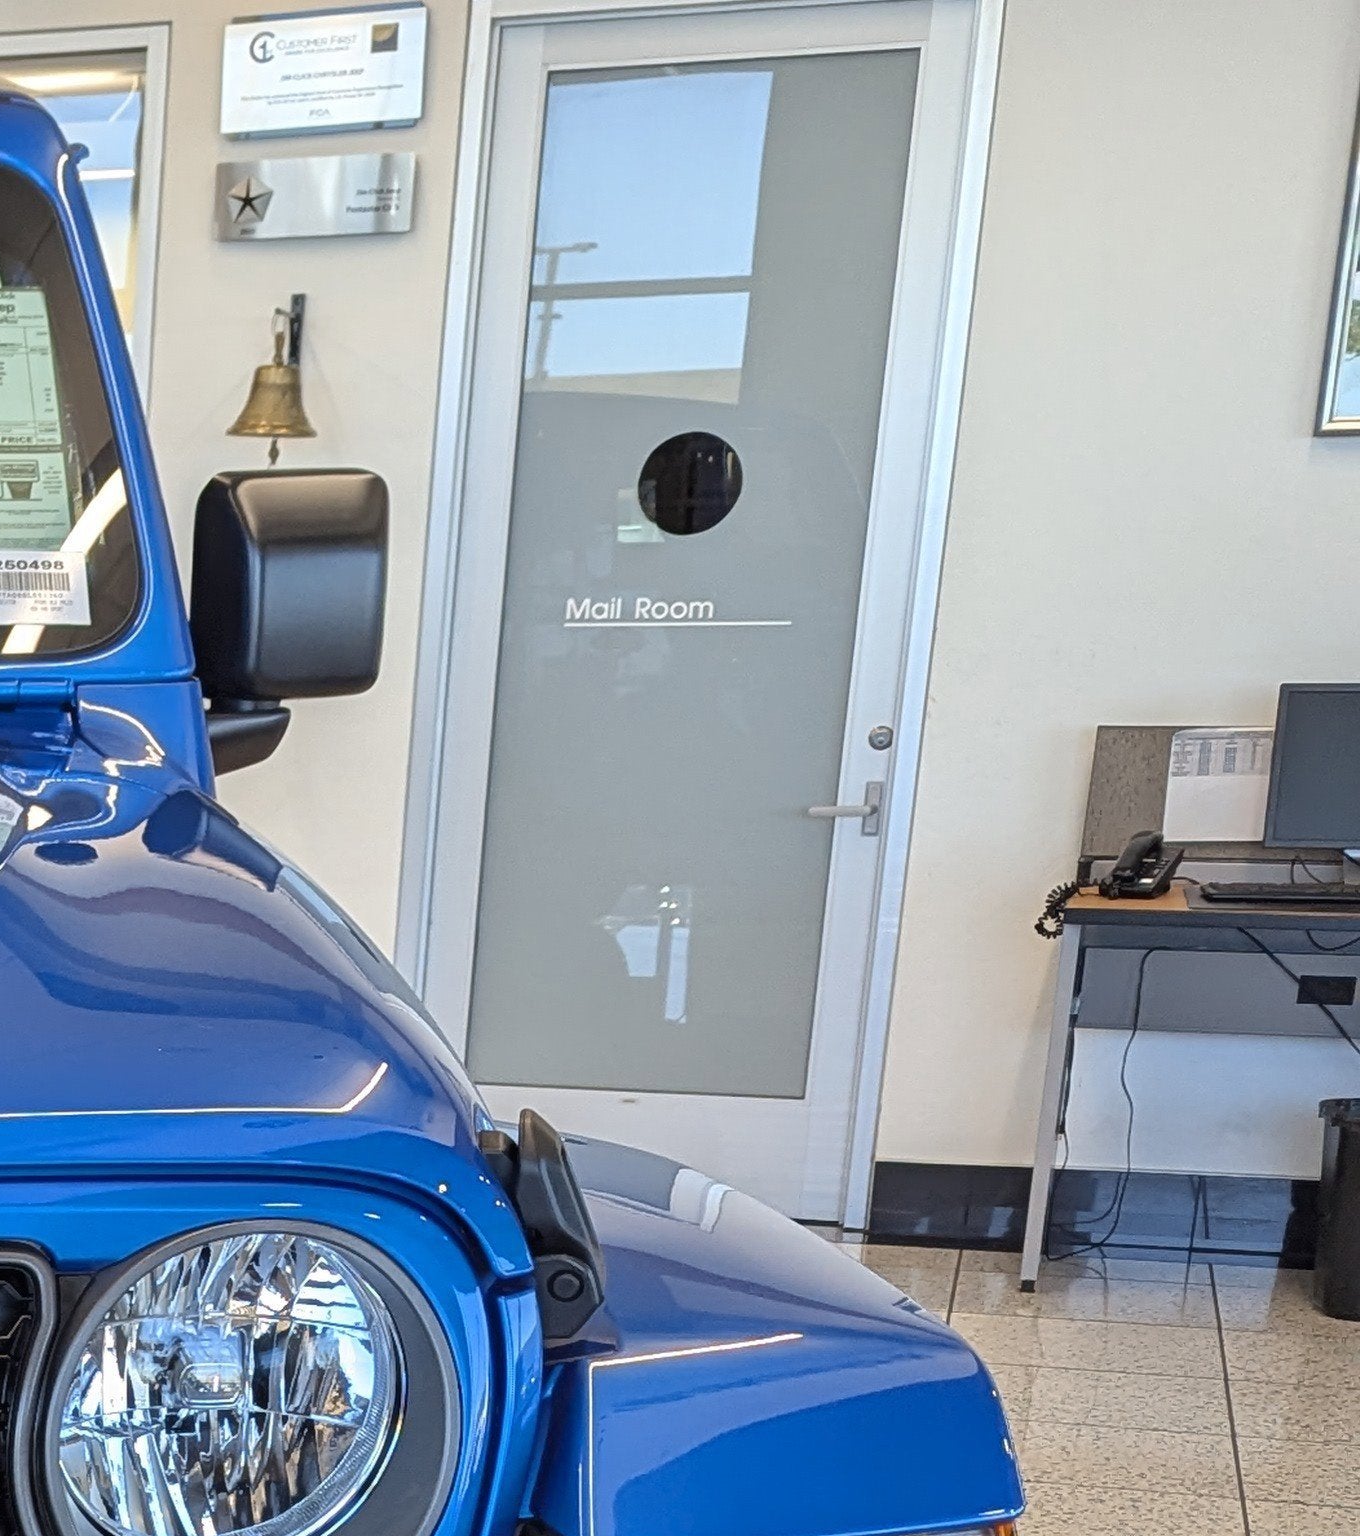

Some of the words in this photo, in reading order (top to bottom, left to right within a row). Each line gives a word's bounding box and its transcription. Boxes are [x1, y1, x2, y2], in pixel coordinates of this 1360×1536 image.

[0, 435, 34, 444] PRICE
[564, 596, 622, 620] Mail
[634, 596, 715, 620] Room
